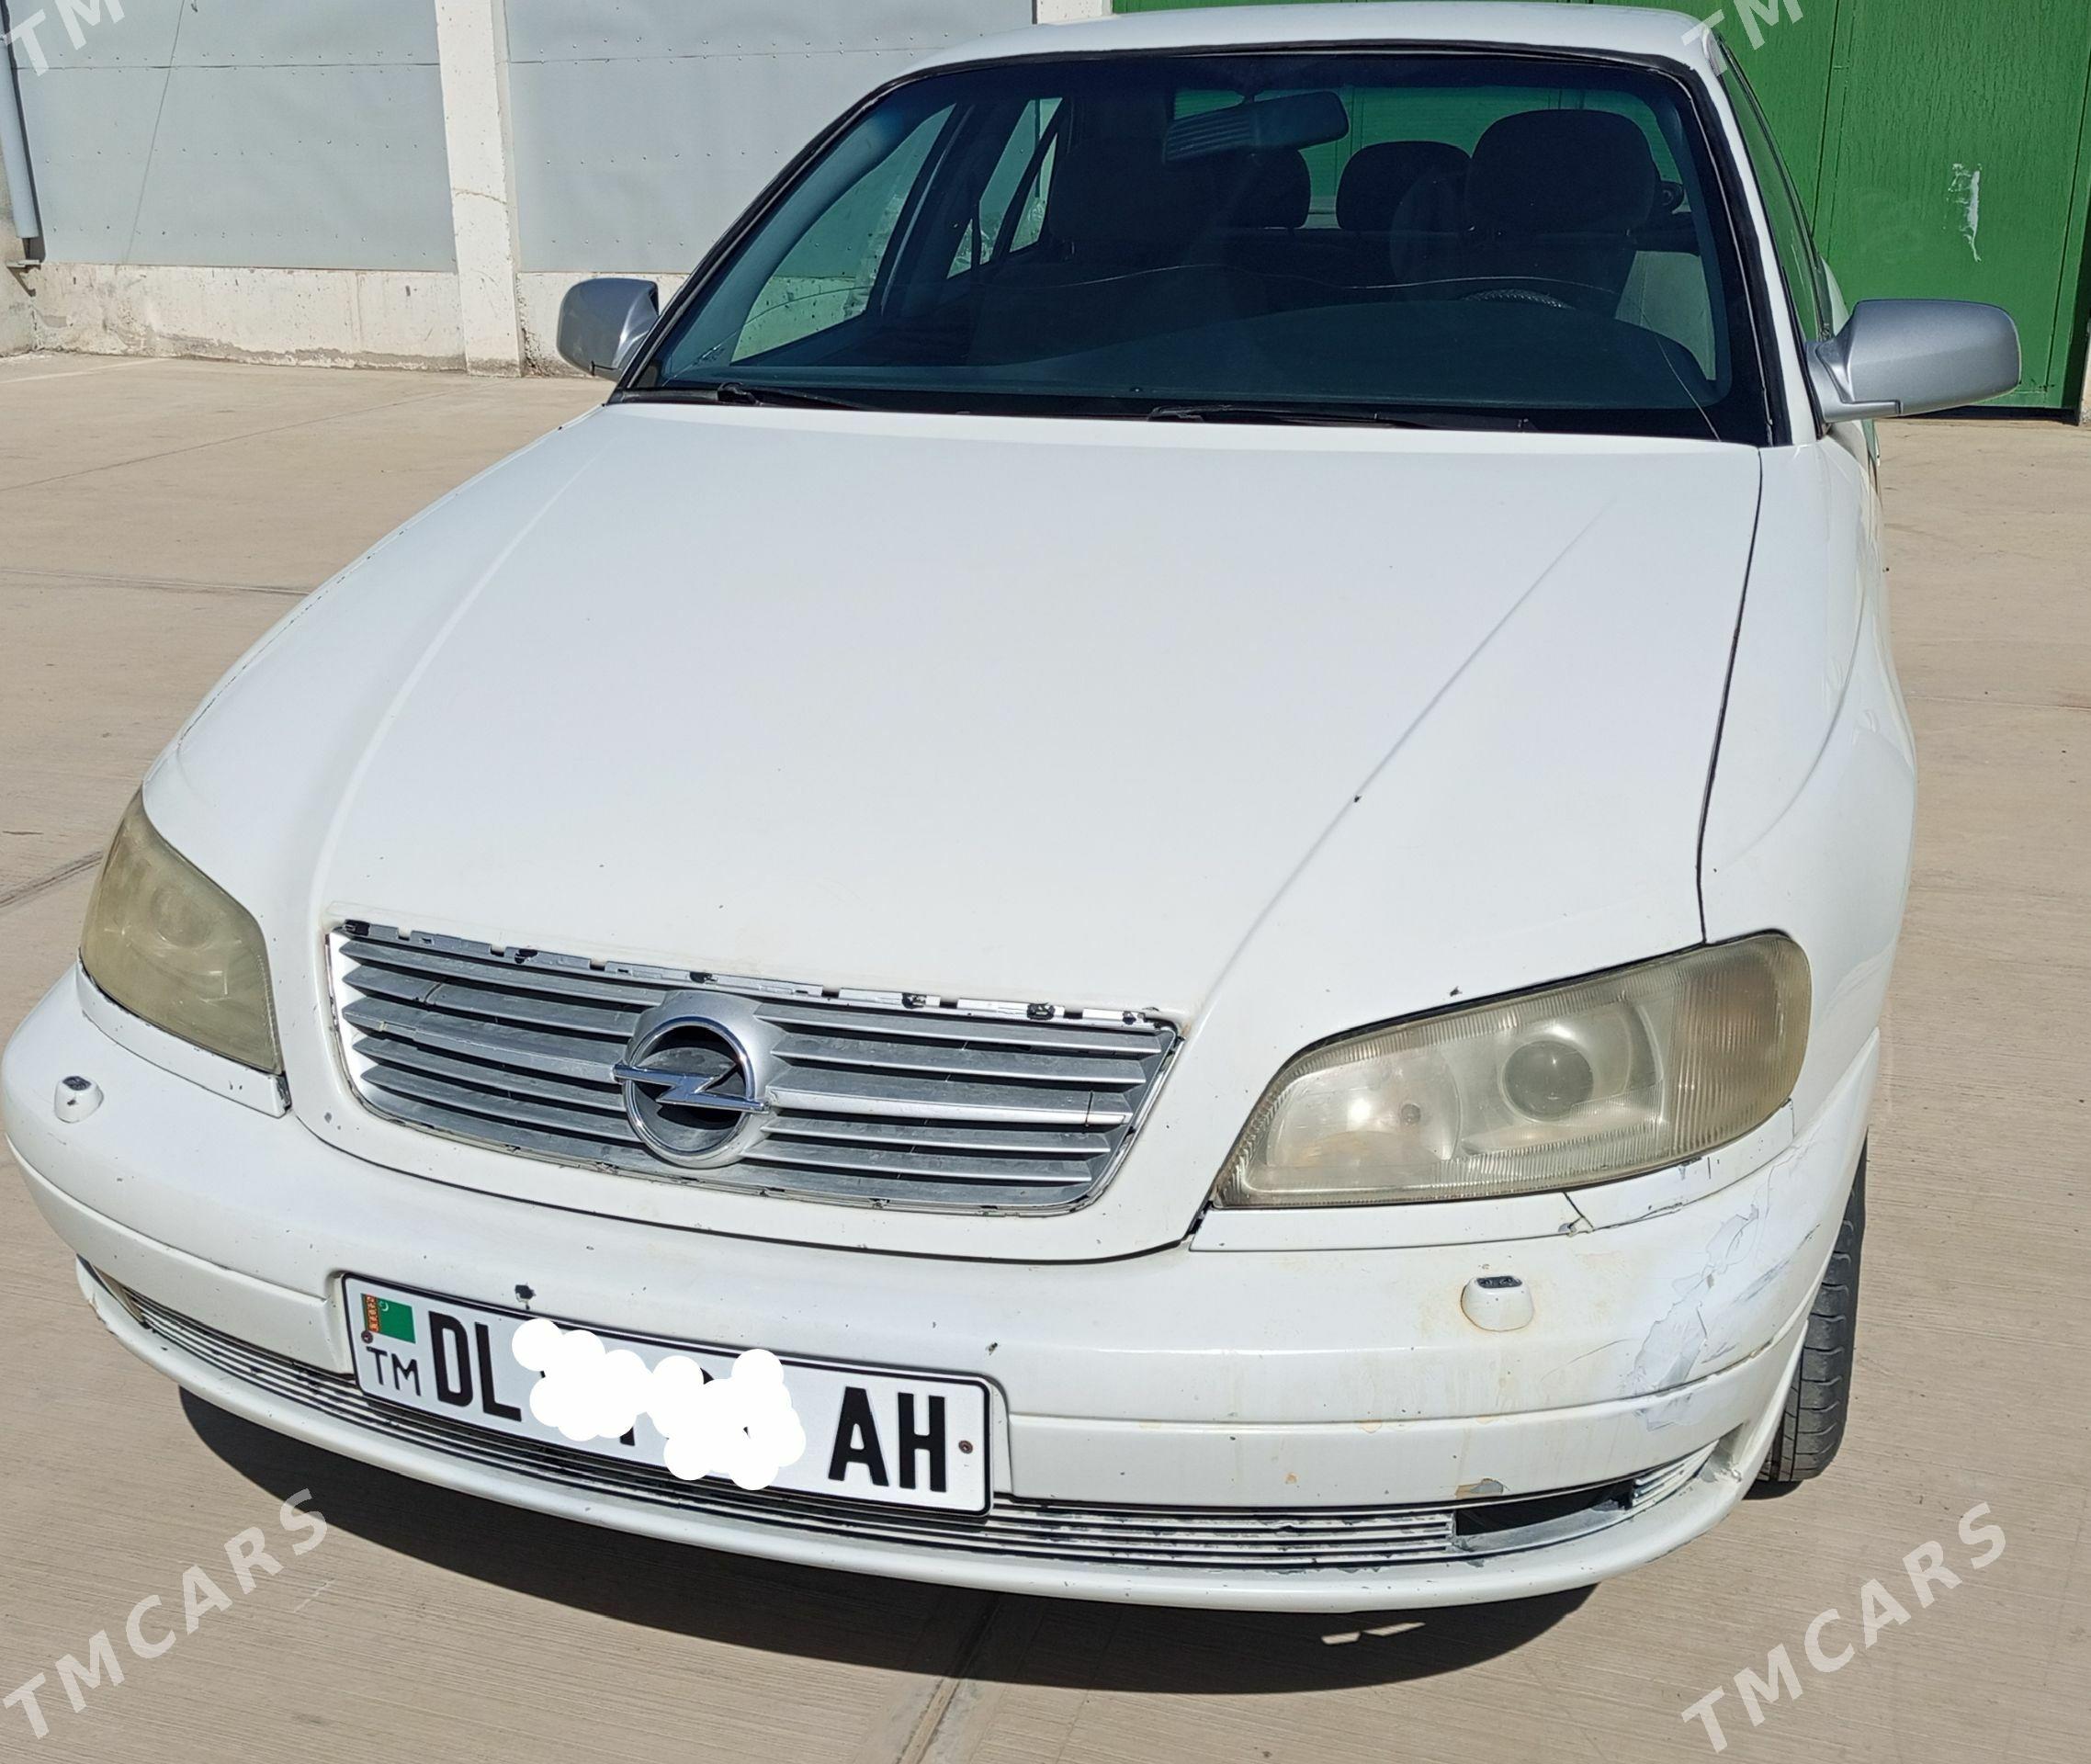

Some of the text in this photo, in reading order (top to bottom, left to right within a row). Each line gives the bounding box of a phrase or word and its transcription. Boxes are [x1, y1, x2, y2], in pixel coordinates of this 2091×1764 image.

[367, 1346, 421, 1387] TM
[428, 1310, 522, 1422] DL
[828, 1386, 946, 1492] AH
